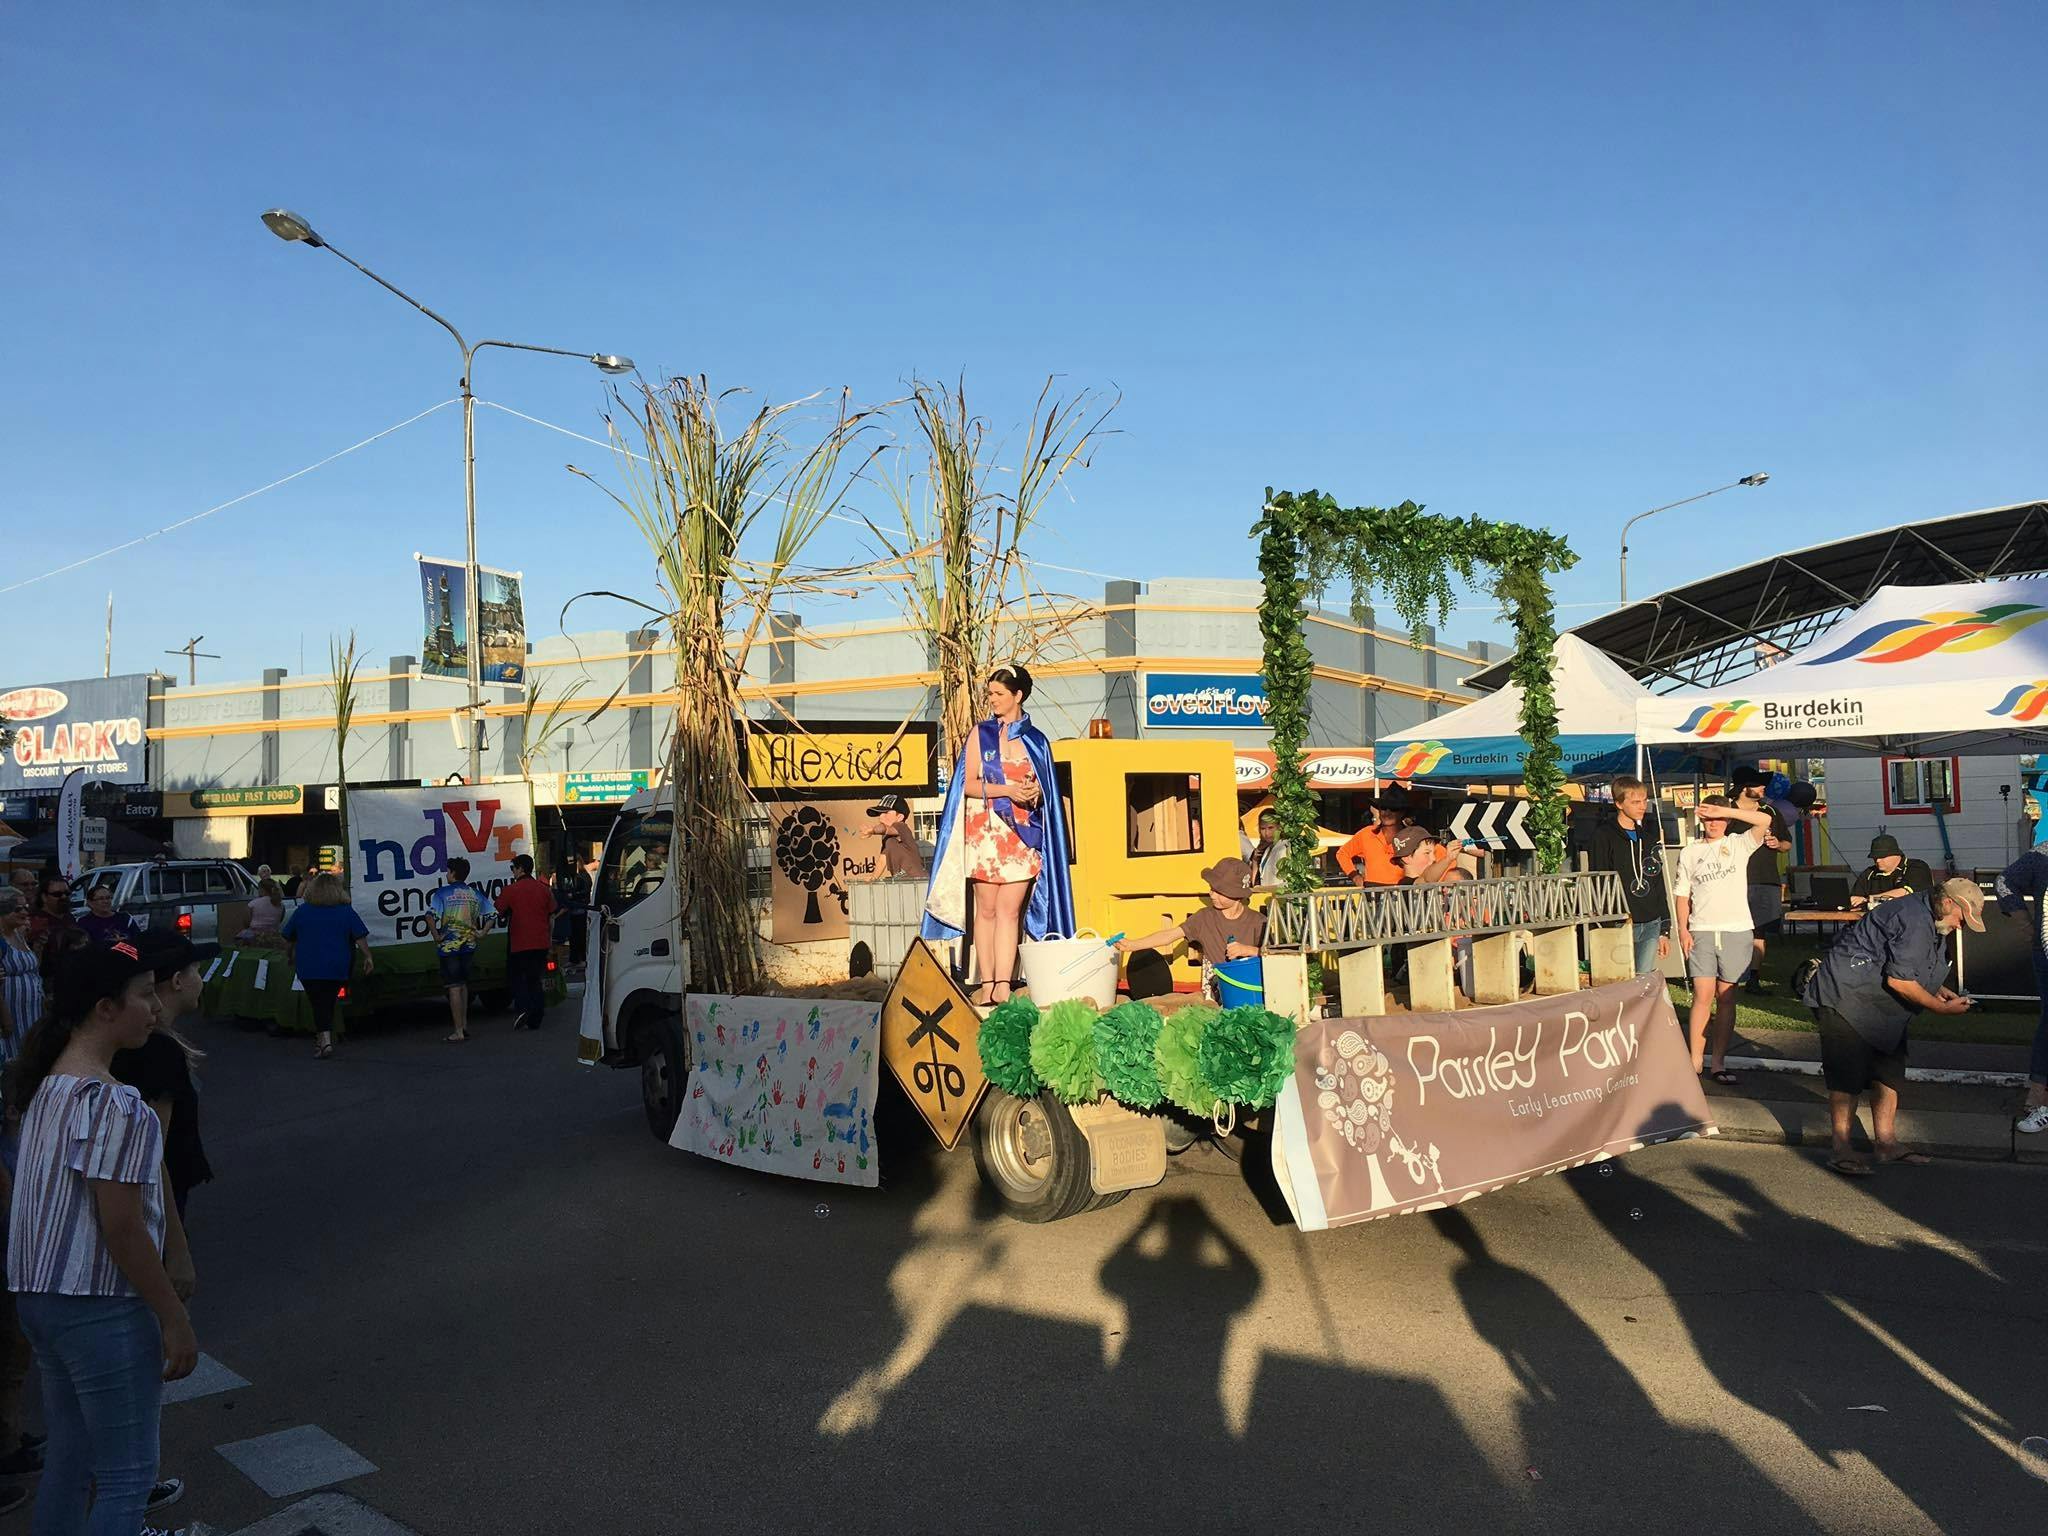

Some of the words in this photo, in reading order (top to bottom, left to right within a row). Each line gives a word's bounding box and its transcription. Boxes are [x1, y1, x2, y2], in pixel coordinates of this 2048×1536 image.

[1764, 698, 1862, 718] Burdekin
[1765, 719, 1802, 730] Shire
[1807, 715, 1863, 728] Council
[13, 717, 141, 766] CLARK'S
[1453, 751, 1508, 765] Burdekin
[1557, 750, 1604, 762] ouncil
[23, 766, 60, 777] DISCOUNT
[96, 762, 128, 774] STORES
[244, 791, 264, 801] FAST
[267, 789, 294, 801] FOODS
[126, 804, 158, 817] Eatery
[1707, 862, 1722, 871] Fly
[1407, 1021, 1542, 1106] Paisley
[1559, 1001, 1639, 1078] Park
[1509, 1096, 1543, 1119] Early
[1546, 1086, 1604, 1109] Learning
[1113, 1148, 1146, 1166] BODIES
